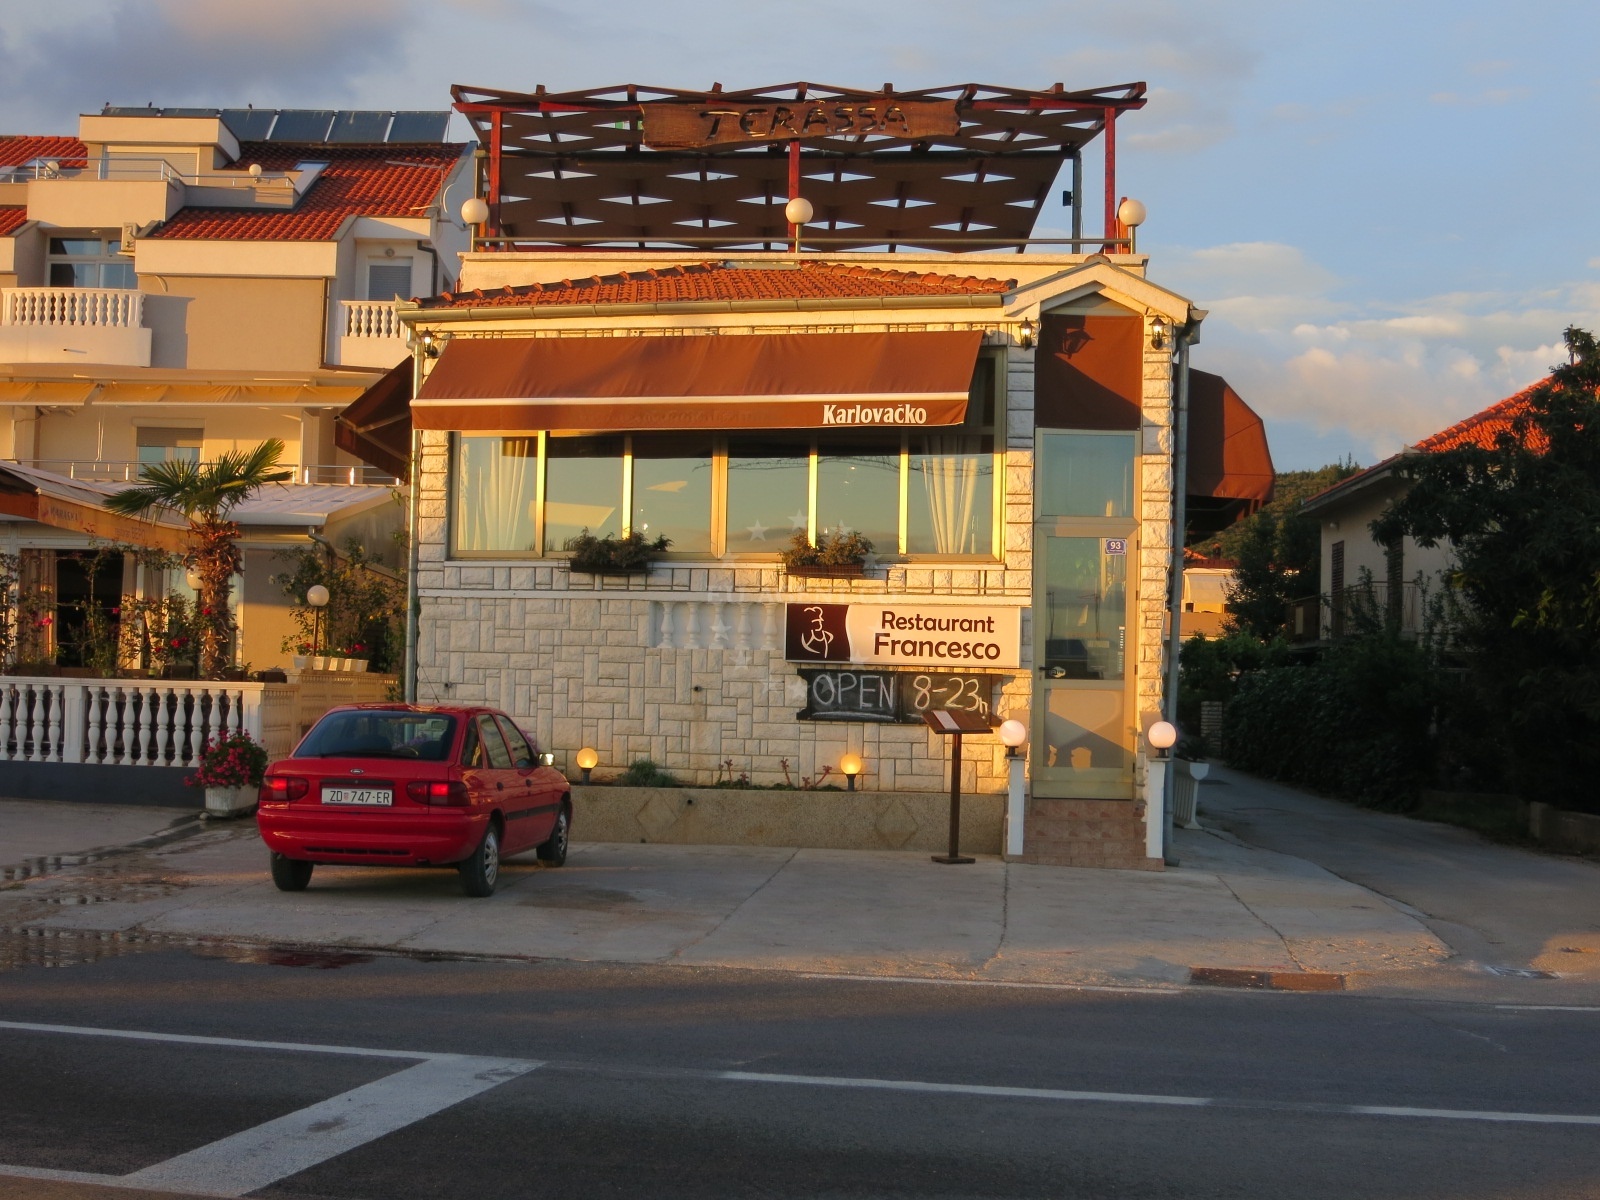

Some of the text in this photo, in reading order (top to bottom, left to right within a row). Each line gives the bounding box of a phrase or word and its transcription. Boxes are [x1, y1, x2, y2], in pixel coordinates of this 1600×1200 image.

[700, 106, 910, 141] TERASSA
[822, 404, 927, 425] Karlovačko
[1110, 541, 1121, 550] 93
[881, 610, 995, 634] Restaurant
[874, 632, 1001, 660] Francesco
[812, 673, 894, 710] OPEN
[330, 791, 390, 804] ZD 747-ER
